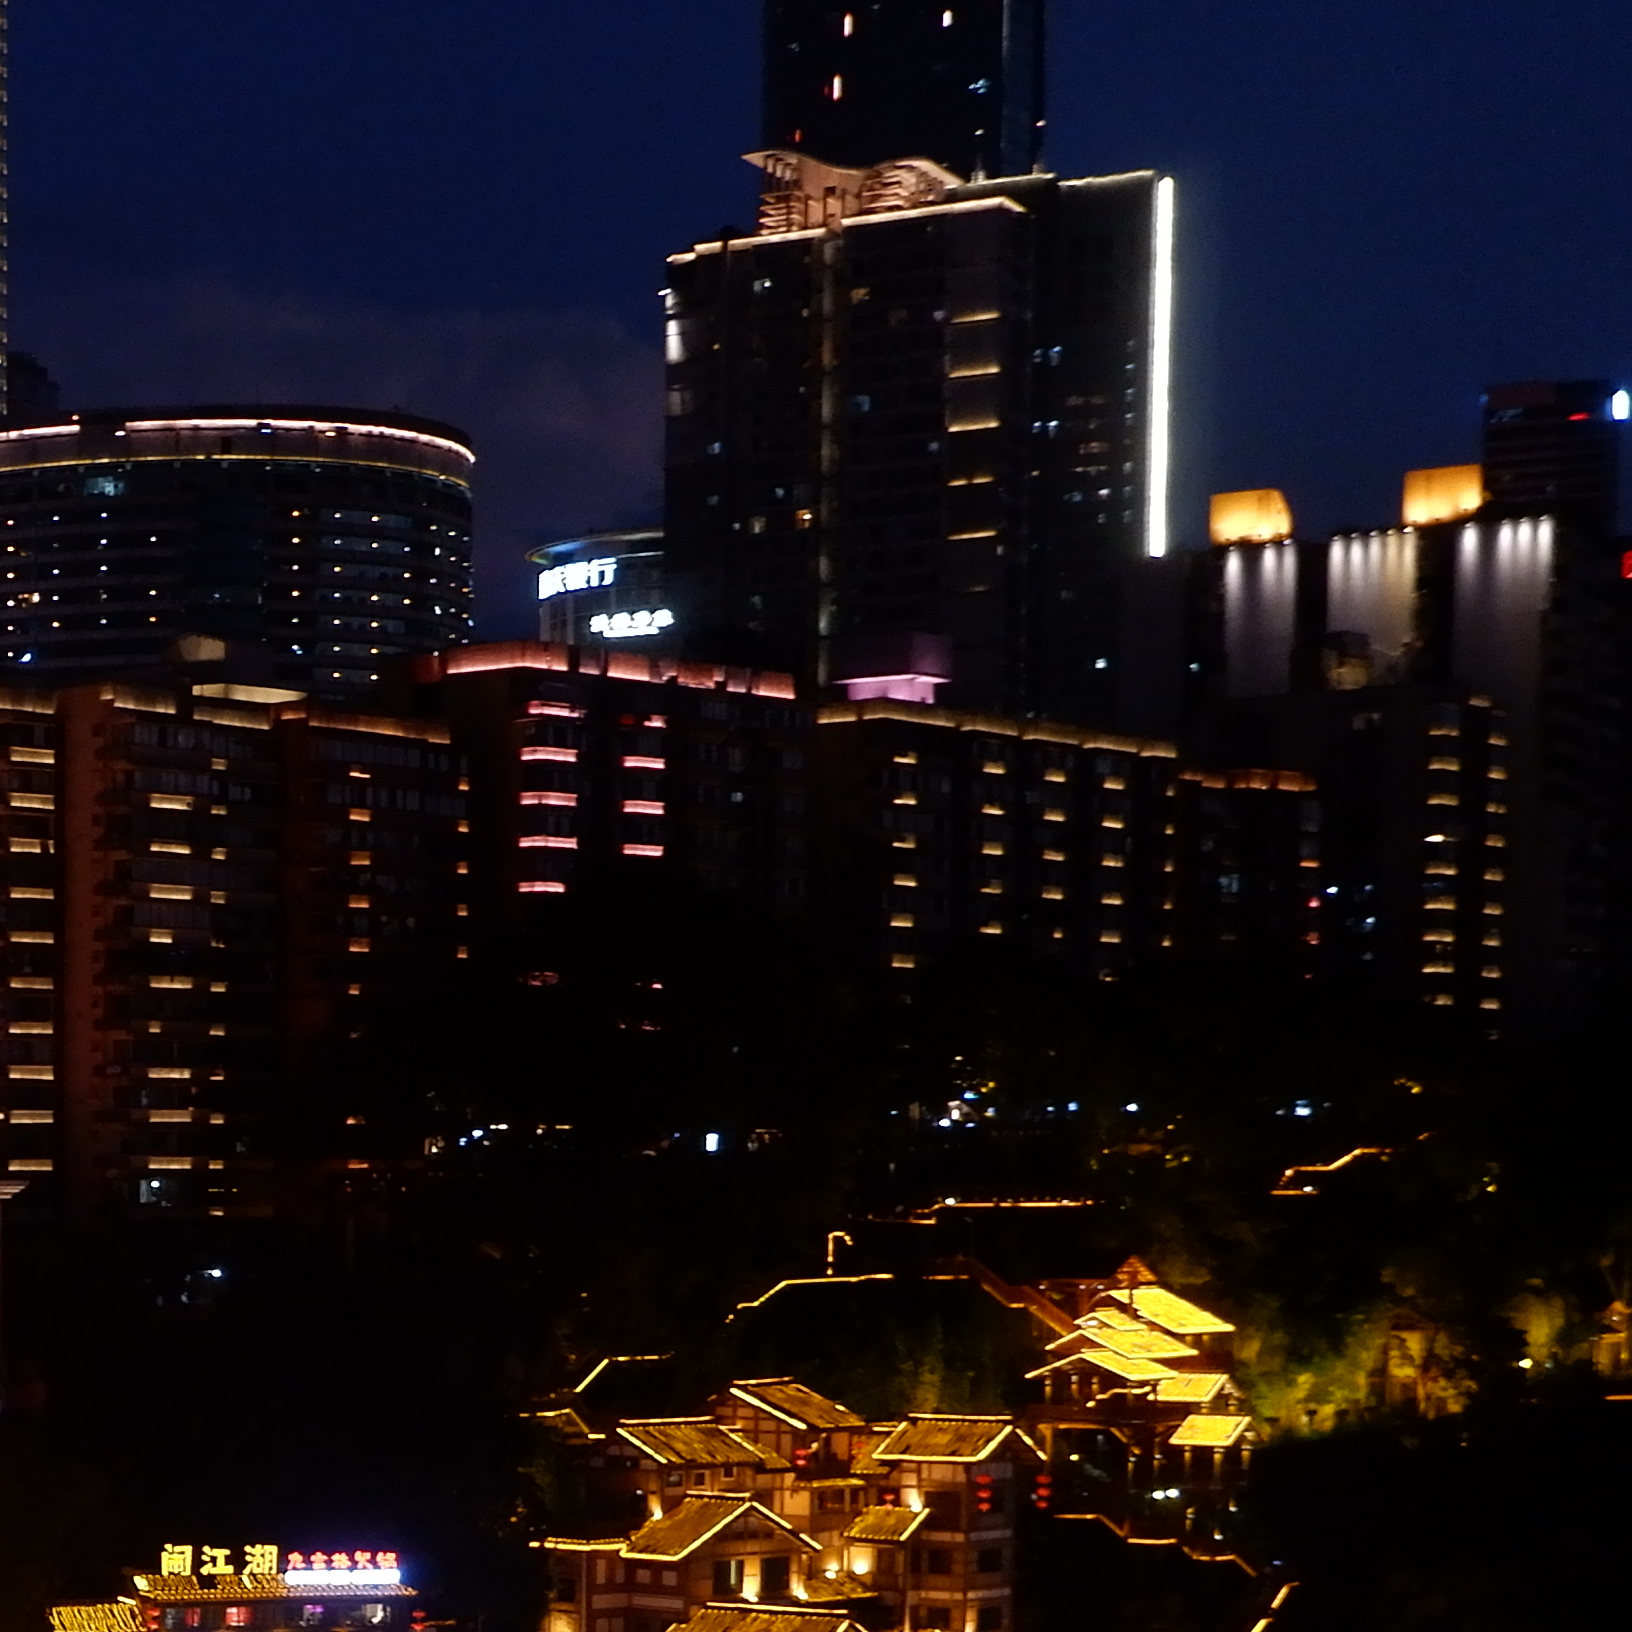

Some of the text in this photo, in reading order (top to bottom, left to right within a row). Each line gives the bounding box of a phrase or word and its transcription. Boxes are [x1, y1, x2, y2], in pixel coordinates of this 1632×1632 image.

[160, 1544, 279, 1576] 闹江湖
[287, 1551, 398, 1570] 九宫格火锅
